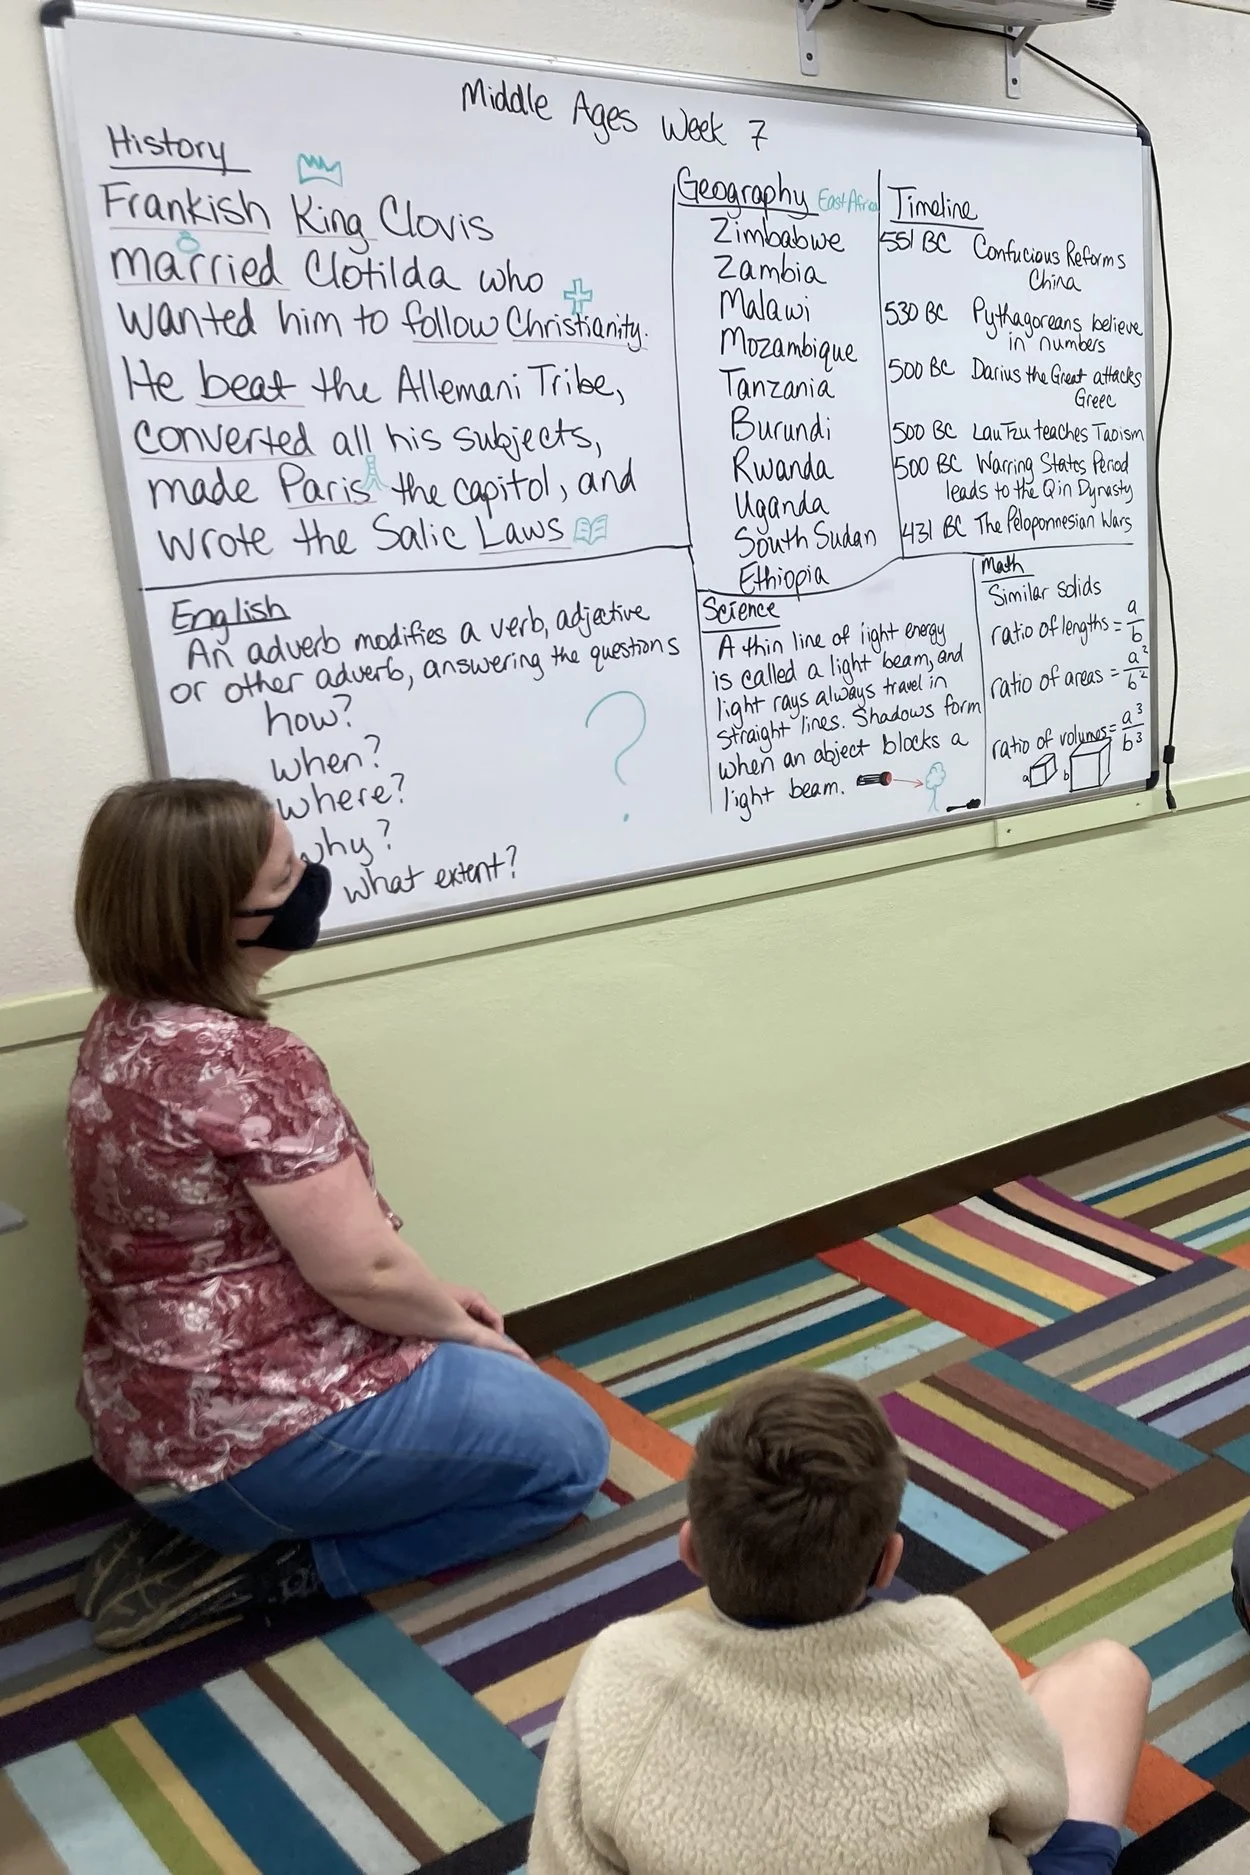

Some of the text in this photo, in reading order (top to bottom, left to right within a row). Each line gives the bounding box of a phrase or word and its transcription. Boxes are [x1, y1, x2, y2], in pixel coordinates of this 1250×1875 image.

[462, 78, 768, 151] Middle Ages Week 7
[106, 124, 226, 175] History
[677, 166, 844, 220] Geography East
[887, 186, 978, 220] Timeline
[99, 181, 494, 255] Frankish King Clovis
[710, 217, 845, 252] Zimbabwe
[110, 244, 543, 293] married Clotilda who
[714, 252, 827, 284] Zambia
[879, 229, 1126, 269] 551 BC Confucious Reforms
[1029, 268, 1081, 292] China
[720, 287, 809, 322] Malawi
[885, 296, 1143, 340] 530 BC Pythagoreans believe
[278, 300, 648, 353] him to follow Christianity.
[1040, 333, 1105, 353] numbers
[721, 326, 857, 373] Mozambique
[121, 355, 624, 405] He beat the Allemani Tribe,
[719, 367, 835, 401] Tanzania
[888, 356, 1142, 388] 500 BC Darius the Great attacks
[1075, 387, 1116, 409] Greec
[134, 417, 601, 462] converted all his subjects,
[731, 405, 830, 442] Burundi
[892, 419, 1144, 444] 500 BC teaches Taoism
[148, 457, 636, 510] made Paris the capitol, and
[733, 446, 834, 484] Rwanda
[894, 450, 1128, 485] 500 BC Warring States Period
[735, 489, 830, 535] Uganda
[946, 477, 1133, 509] leads to the Dynasty
[157, 512, 564, 561] wrote the Salic Laws
[734, 520, 876, 558] South Sudan
[901, 519, 932, 543] 431
[943, 515, 967, 539] BC
[974, 511, 1003, 535] The
[1101, 509, 1132, 533] Wars
[740, 561, 830, 601] Ethiopia
[982, 553, 1024, 575] Math
[703, 596, 780, 624] Science
[988, 574, 1101, 606] Similar solids
[171, 594, 291, 645] English
[188, 600, 650, 670] An adverb modifies a verb, adjective
[991, 613, 1109, 646] ratio of lengths
[718, 622, 946, 660] A thin line of light energy
[170, 636, 680, 704] or other adverb, answering the questions
[715, 642, 963, 691] is called a light beam, and
[991, 664, 1103, 698] ratio of areas
[264, 694, 351, 736] how?
[717, 674, 947, 730] light rays always travel in
[801, 715, 845, 733] lines.
[852, 704, 934, 724] Shadows
[944, 693, 981, 716] form
[270, 734, 380, 782] when?
[719, 729, 969, 780] when an blocks a
[992, 728, 1053, 759] ratio of
[277, 773, 404, 820] where?
[725, 777, 845, 822] light beam.
[343, 845, 517, 904] what extent?
